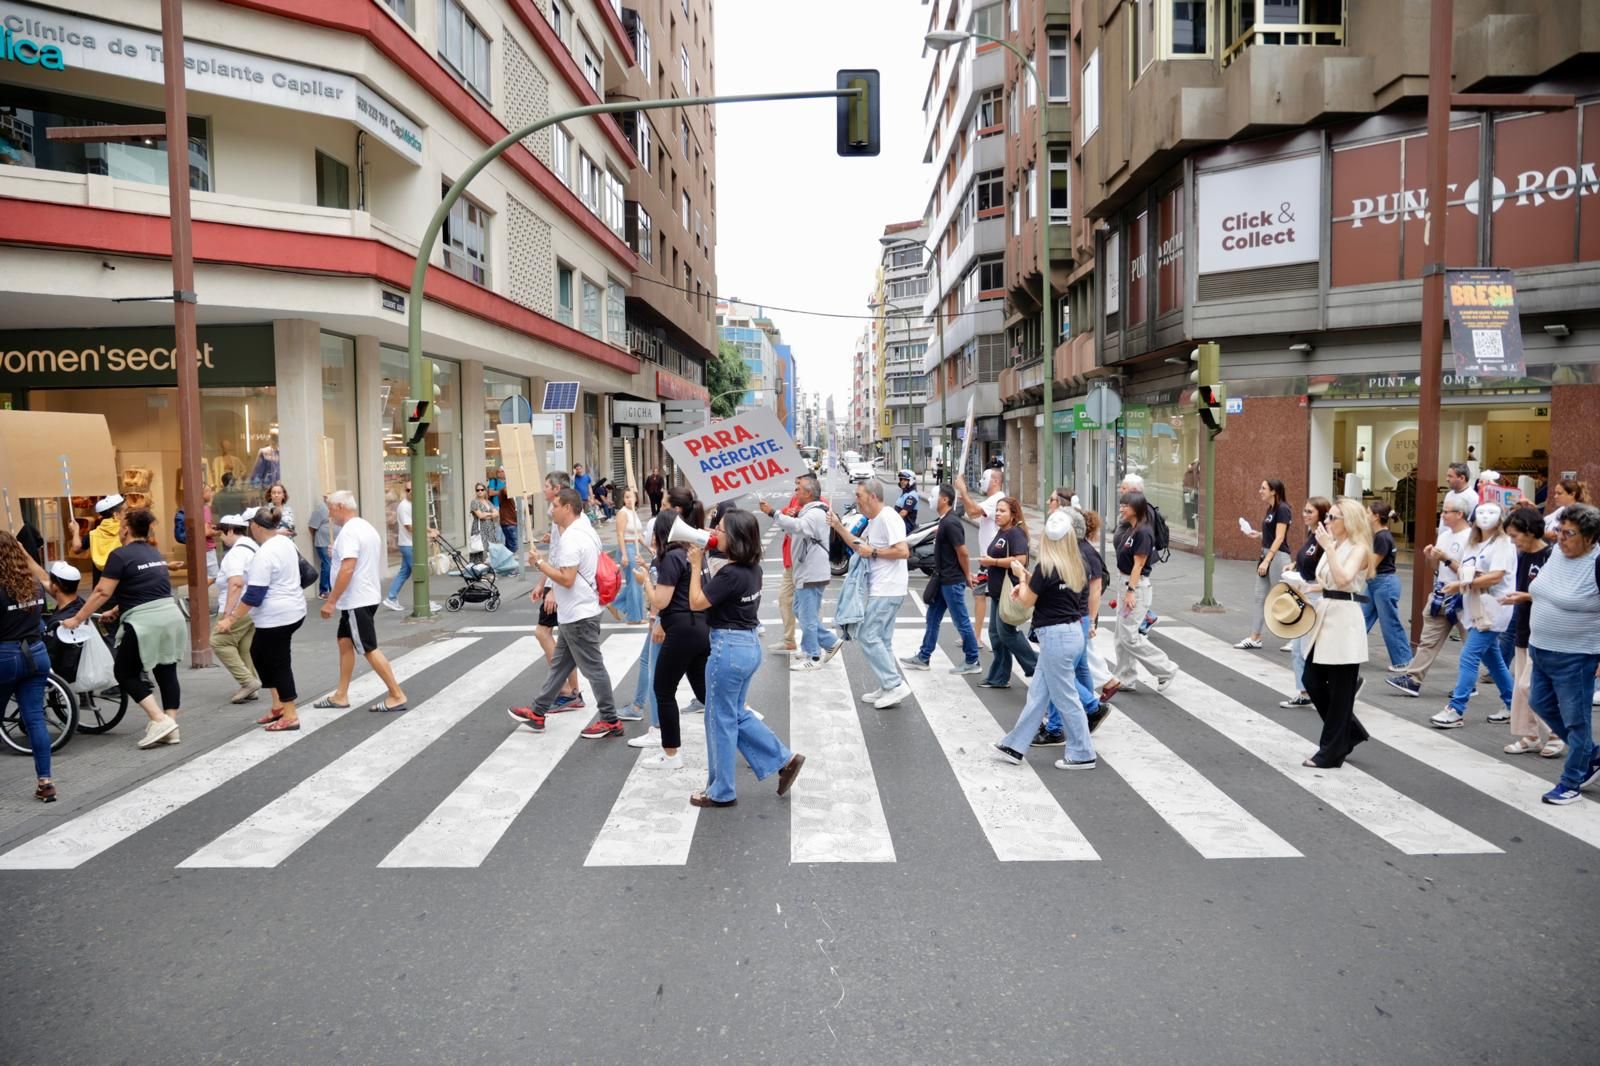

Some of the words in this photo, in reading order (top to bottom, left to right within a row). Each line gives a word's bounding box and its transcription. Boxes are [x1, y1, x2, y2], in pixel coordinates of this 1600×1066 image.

[4, 14, 96, 49] Clínica
[108, 38, 138, 57] de
[271, 73, 344, 99] Capilar
[1222, 210, 1273, 232] Click
[1278, 201, 1295, 224] &
[1222, 227, 1295, 251] Collect
[1450, 284, 1514, 307] BRESH
[1369, 376, 1407, 388] PUNT
[684, 424, 760, 457] PARA.
[699, 438, 784, 474] ACÉRCATE.
[710, 458, 790, 494] ACTÚA.
